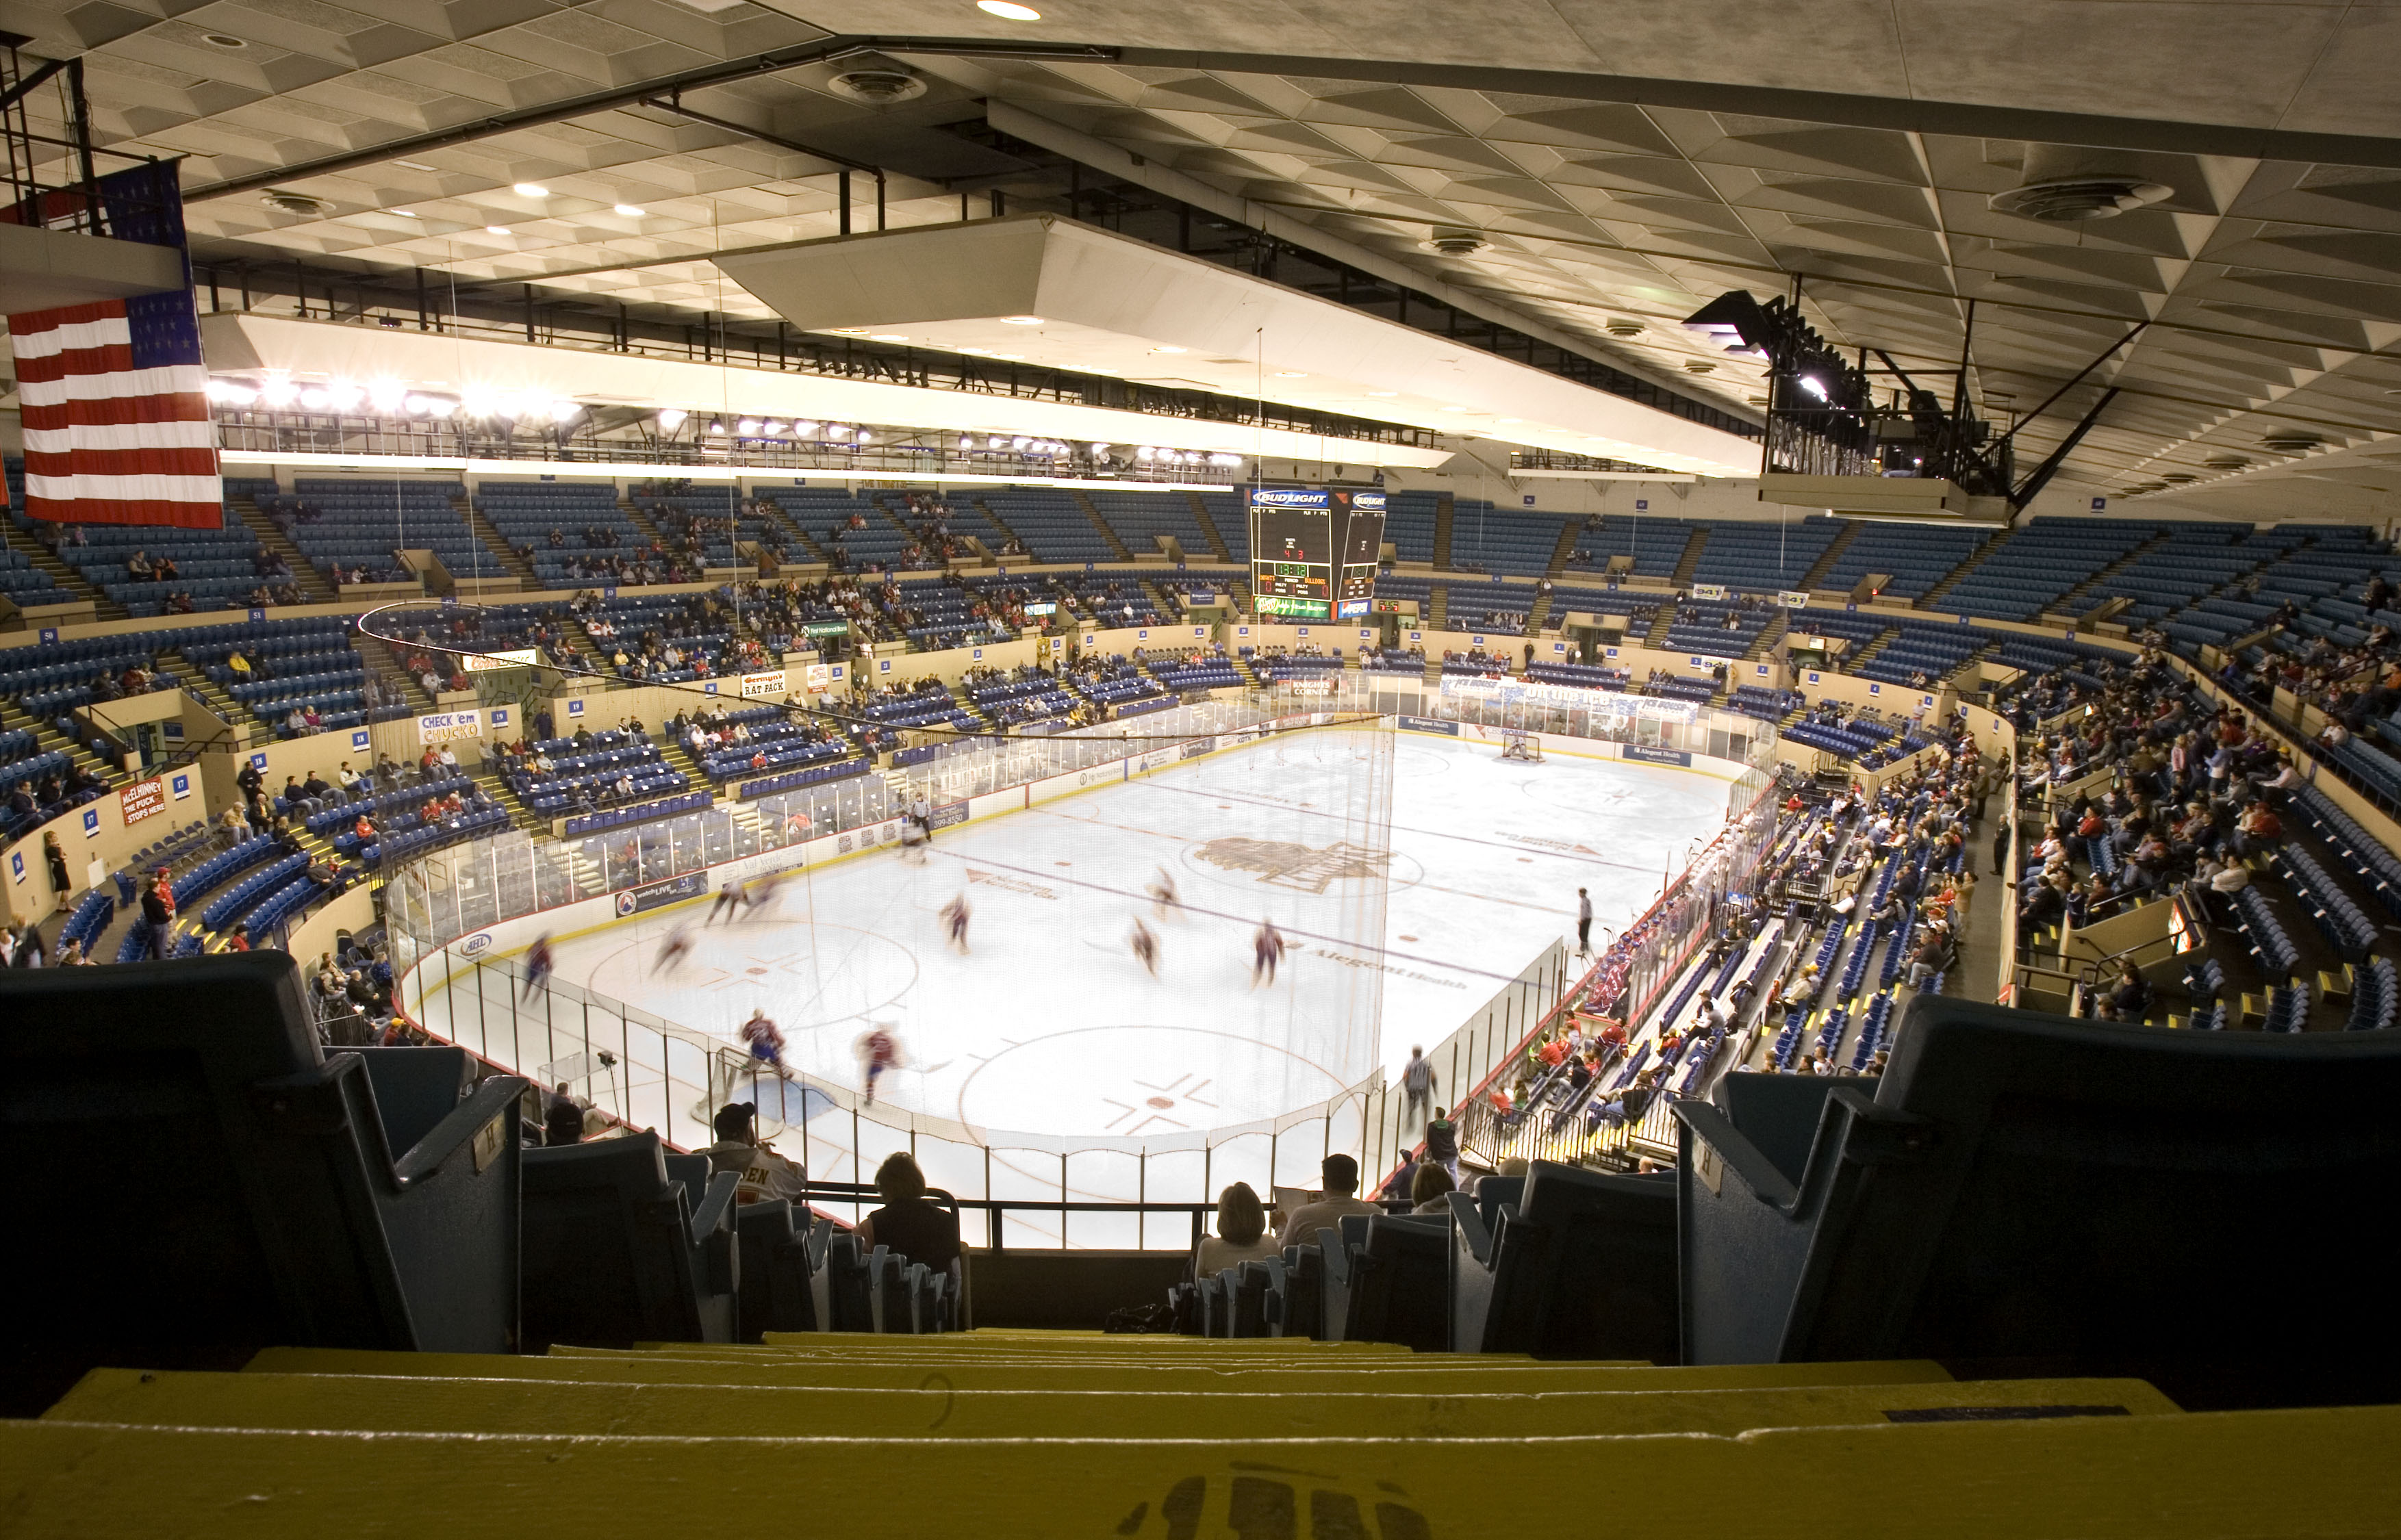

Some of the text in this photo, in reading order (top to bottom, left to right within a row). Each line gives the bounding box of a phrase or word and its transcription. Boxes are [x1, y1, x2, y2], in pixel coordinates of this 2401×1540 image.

[1261, 493, 1327, 504] BUD LIGHT
[1355, 496, 1386, 506] BUD LIGHT
[1284, 550, 1290, 558] 4
[1298, 550, 1304, 559] 3
[1265, 581, 1271, 592] 0
[1322, 585, 1329, 597] 0
[45, 632, 53, 640] 50
[745, 682, 784, 695] RAT PACK
[1551, 687, 1579, 702] the
[422, 714, 475, 729] CHECK 'em
[1434, 720, 1449, 729] Health
[138, 726, 147, 749] MEN
[357, 734, 364, 743] 18
[424, 723, 478, 743] CHUCKO
[1641, 749, 1681, 759] Alegent Health
[255, 757, 263, 765] 18
[177, 780, 184, 788] 17
[123, 782, 162, 806] McELHINNEY
[124, 795, 155, 814] THE PUCK
[128, 803, 165, 823] STOPS HERE
[88, 814, 94, 825] 17
[934, 813, 963, 828] 399-8550
[861, 829, 874, 837] BIG
[883, 823, 894, 832] BIG
[838, 835, 851, 843] BIG
[637, 888, 657, 899] watch
[656, 884, 672, 895] LIVE
[466, 936, 486, 953] AHL
[1317, 949, 1468, 990] Alegent Health
[1612, 979, 1618, 991] 3
[485, 1122, 496, 1154] H
[1702, 1150, 1712, 1176] H
